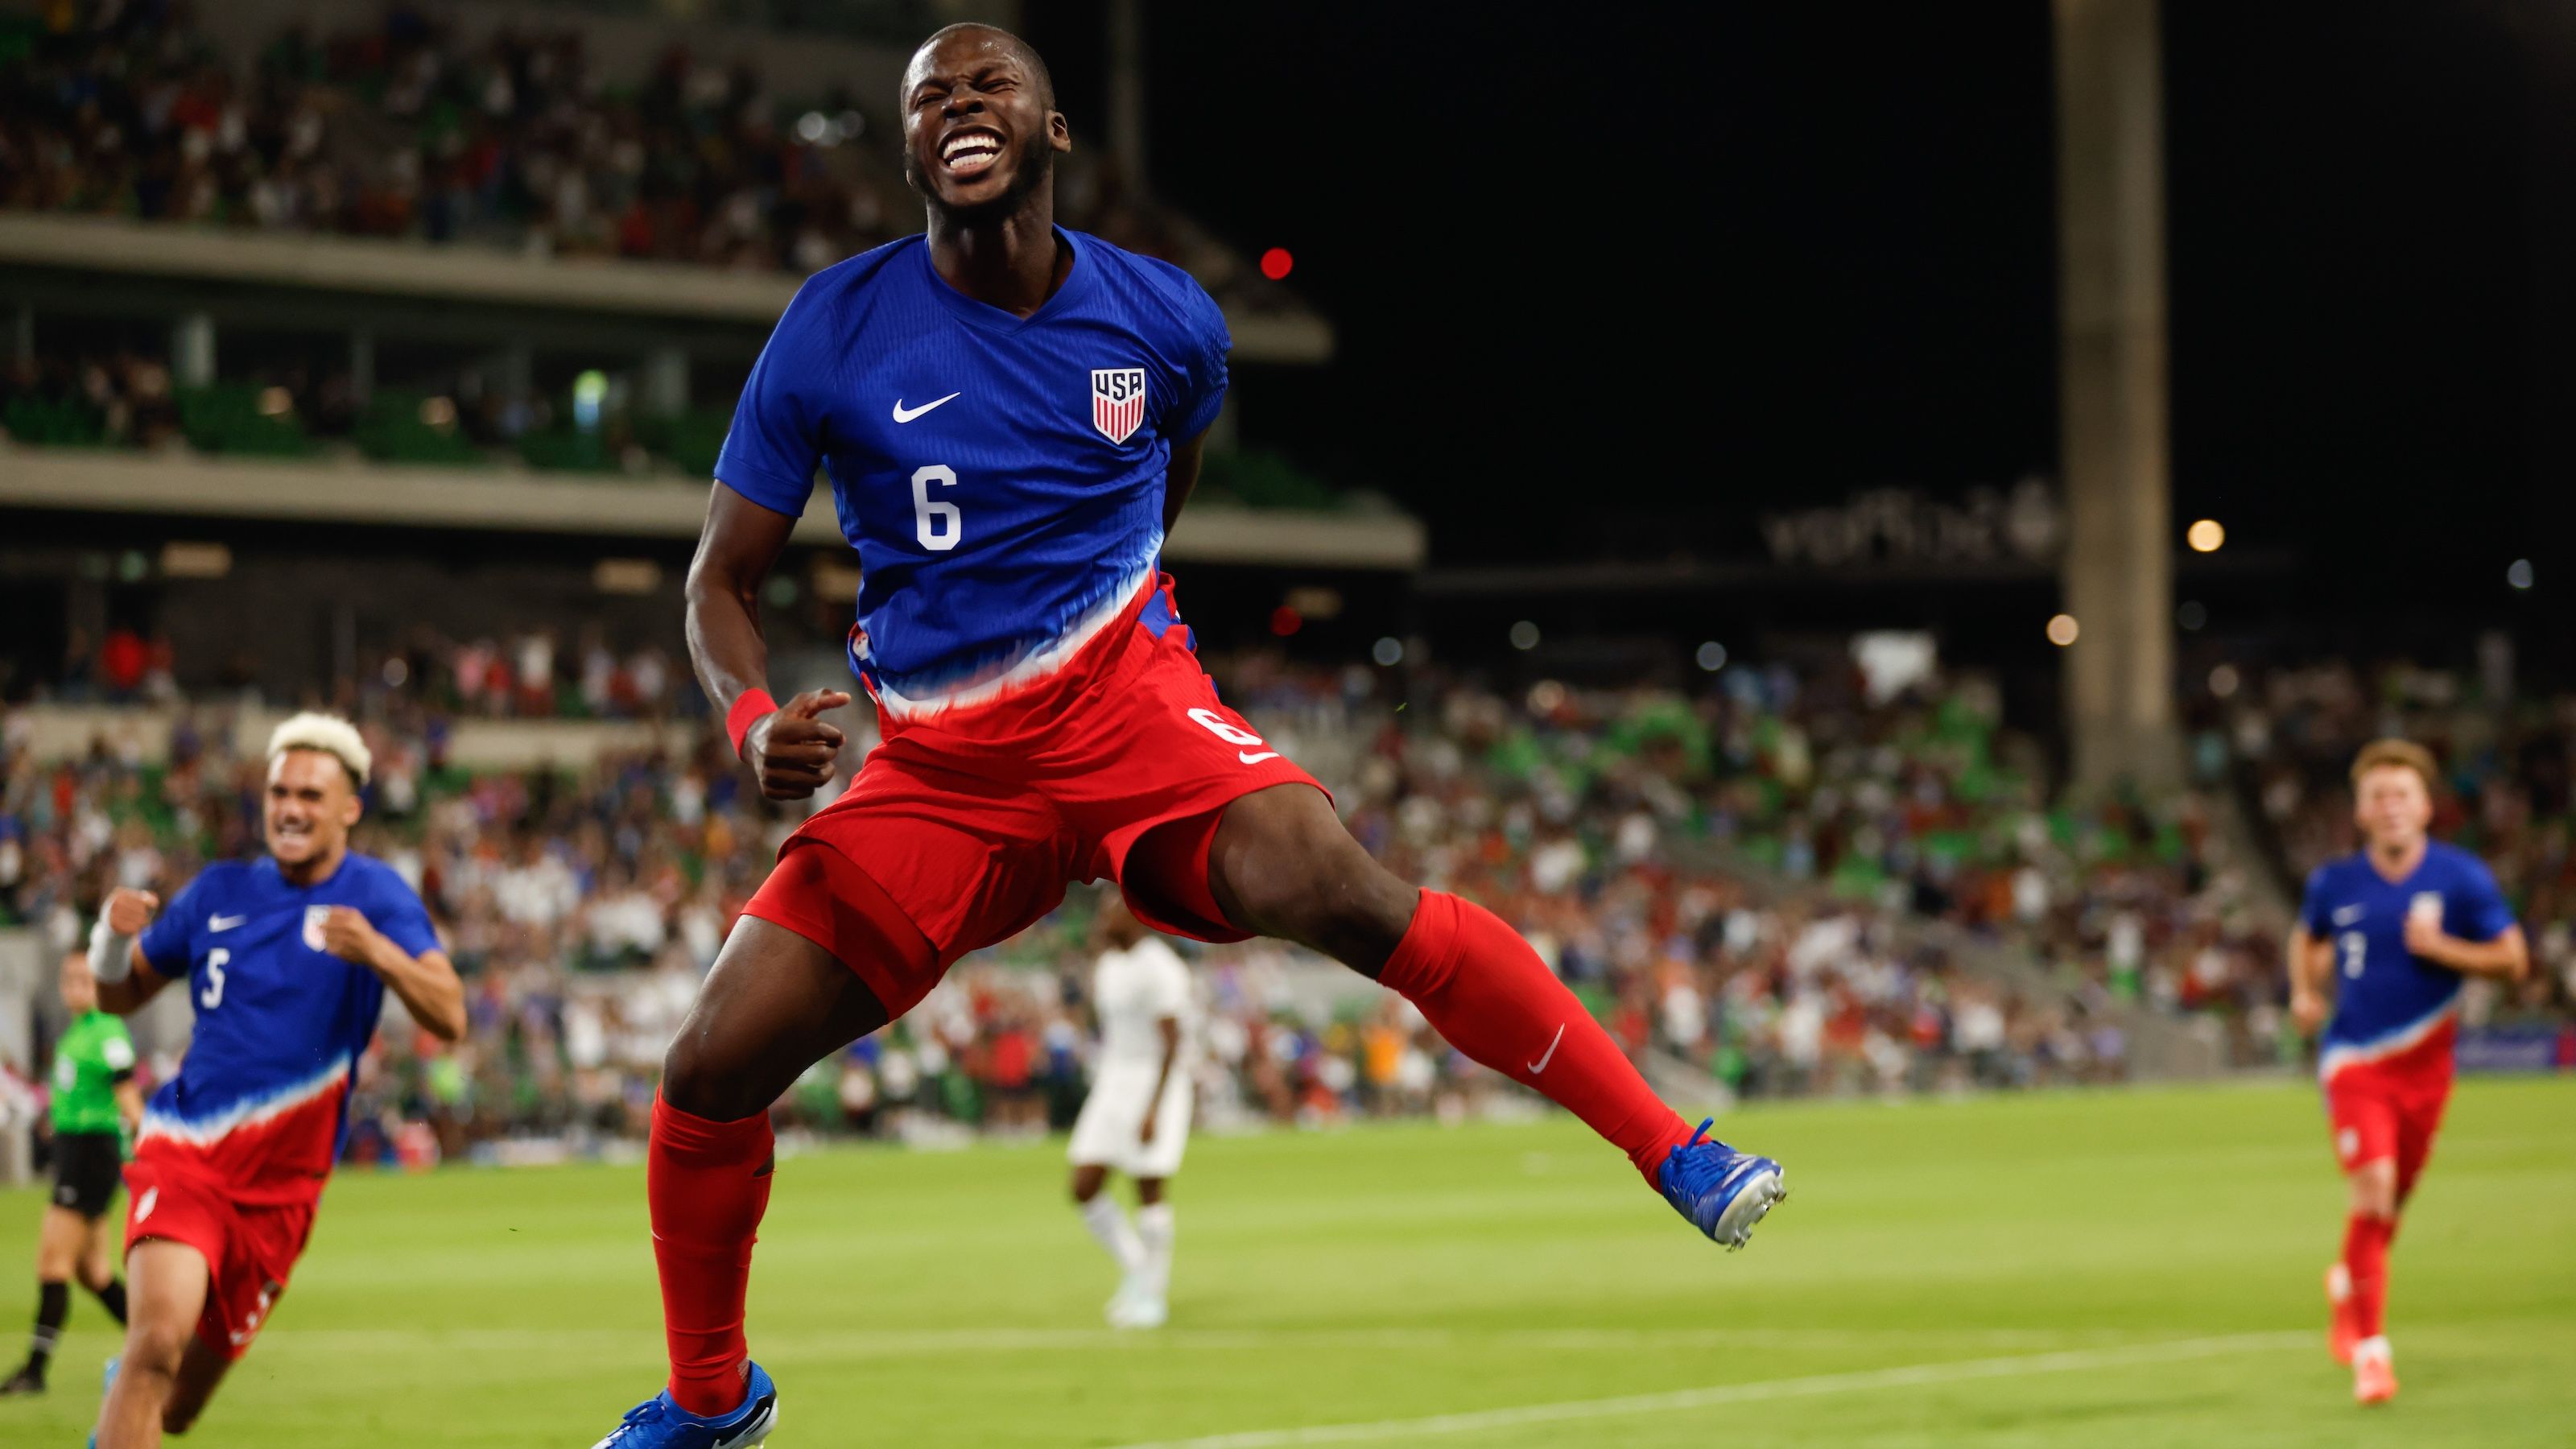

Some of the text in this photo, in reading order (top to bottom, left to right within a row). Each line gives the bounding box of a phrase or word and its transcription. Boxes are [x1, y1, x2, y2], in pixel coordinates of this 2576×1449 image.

[1096, 372, 1142, 401] USA
[911, 464, 961, 551] 6
[1187, 708, 1263, 745] 6
[201, 947, 230, 1009] 5
